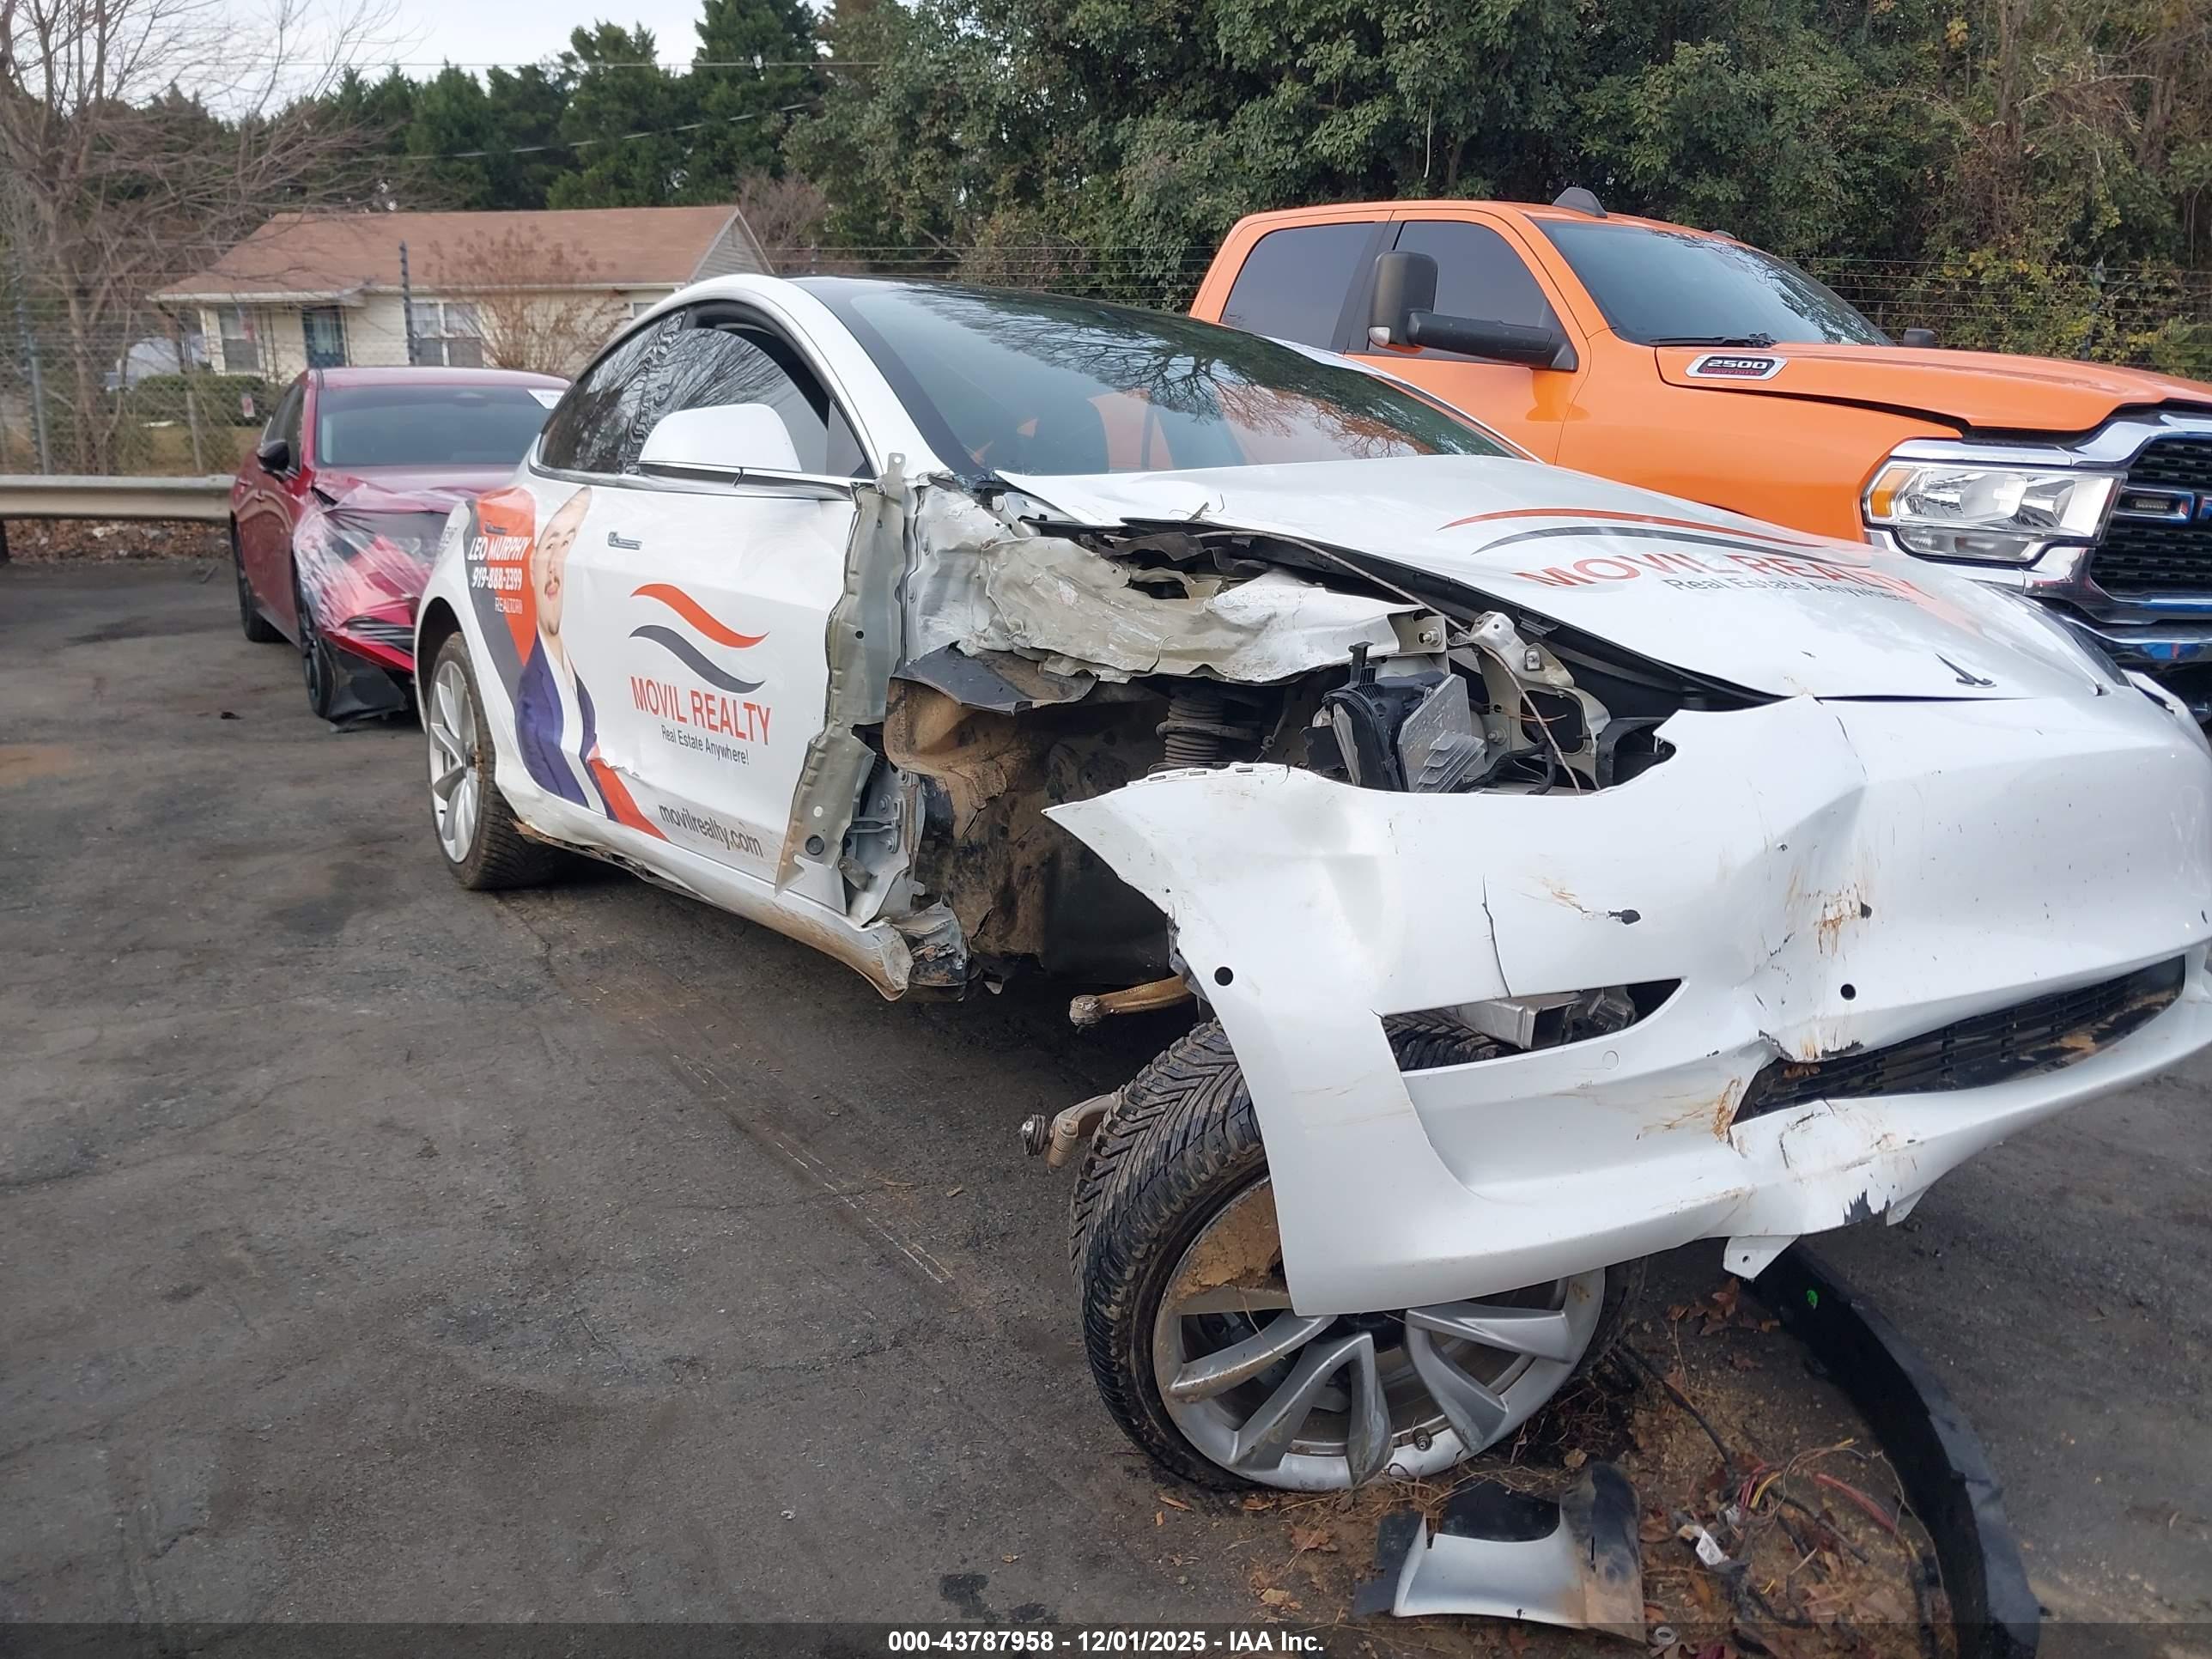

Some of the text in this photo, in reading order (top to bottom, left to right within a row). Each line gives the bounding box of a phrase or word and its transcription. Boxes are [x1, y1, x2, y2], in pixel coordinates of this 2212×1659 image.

[1707, 359, 1768, 369] 2500
[467, 536, 489, 560] LEO
[487, 536, 533, 561] MURPHY
[471, 567, 523, 592] 919-888-2399
[1511, 553, 1936, 600] MOVIL REALTY
[1664, 578, 1726, 591] Real
[1734, 577, 1808, 591] Estate
[630, 676, 771, 745] MOVIL REALTY
[661, 725, 750, 765] Real Estate Anywhere!
[659, 804, 763, 858] movilrealty.com
